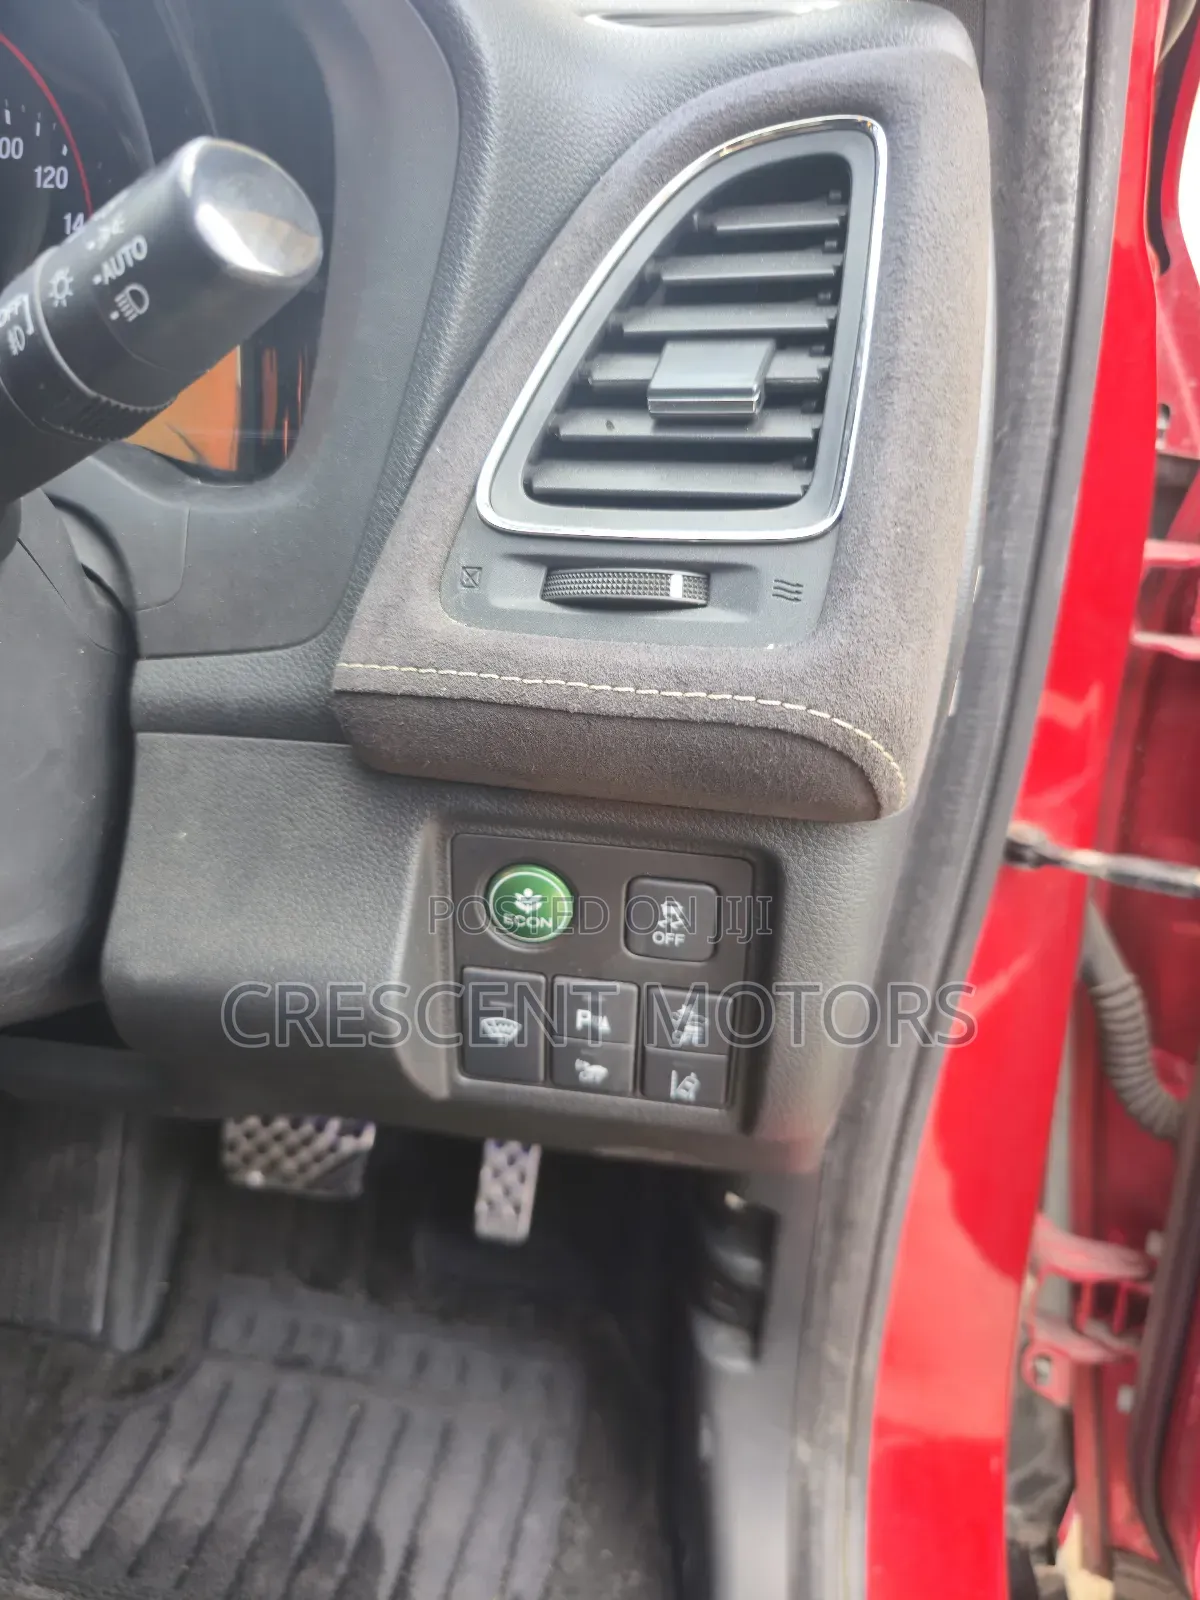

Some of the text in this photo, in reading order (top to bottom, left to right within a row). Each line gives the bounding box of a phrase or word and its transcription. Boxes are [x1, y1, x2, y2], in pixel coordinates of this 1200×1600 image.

[34, 165, 69, 190] 120
[101, 234, 148, 285] AUTO
[503, 912, 554, 931] ECON
[652, 930, 686, 947] OFF
